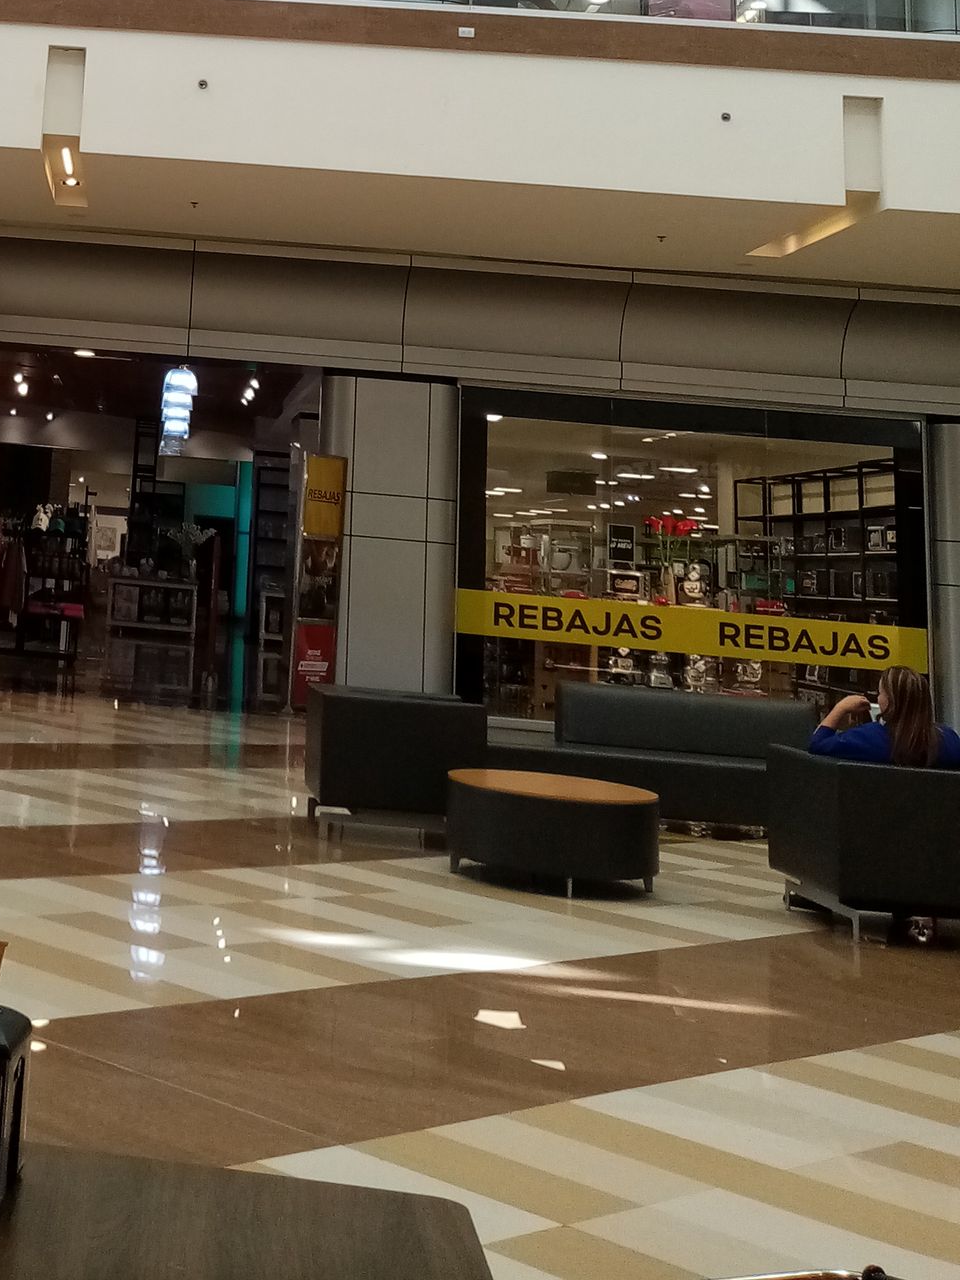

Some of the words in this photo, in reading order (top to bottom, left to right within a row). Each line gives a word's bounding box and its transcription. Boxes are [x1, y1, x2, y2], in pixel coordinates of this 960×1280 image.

[308, 488, 341, 501] REBAJAS
[493, 601, 663, 641] REBAJAS
[718, 622, 891, 660] REBAJAS
